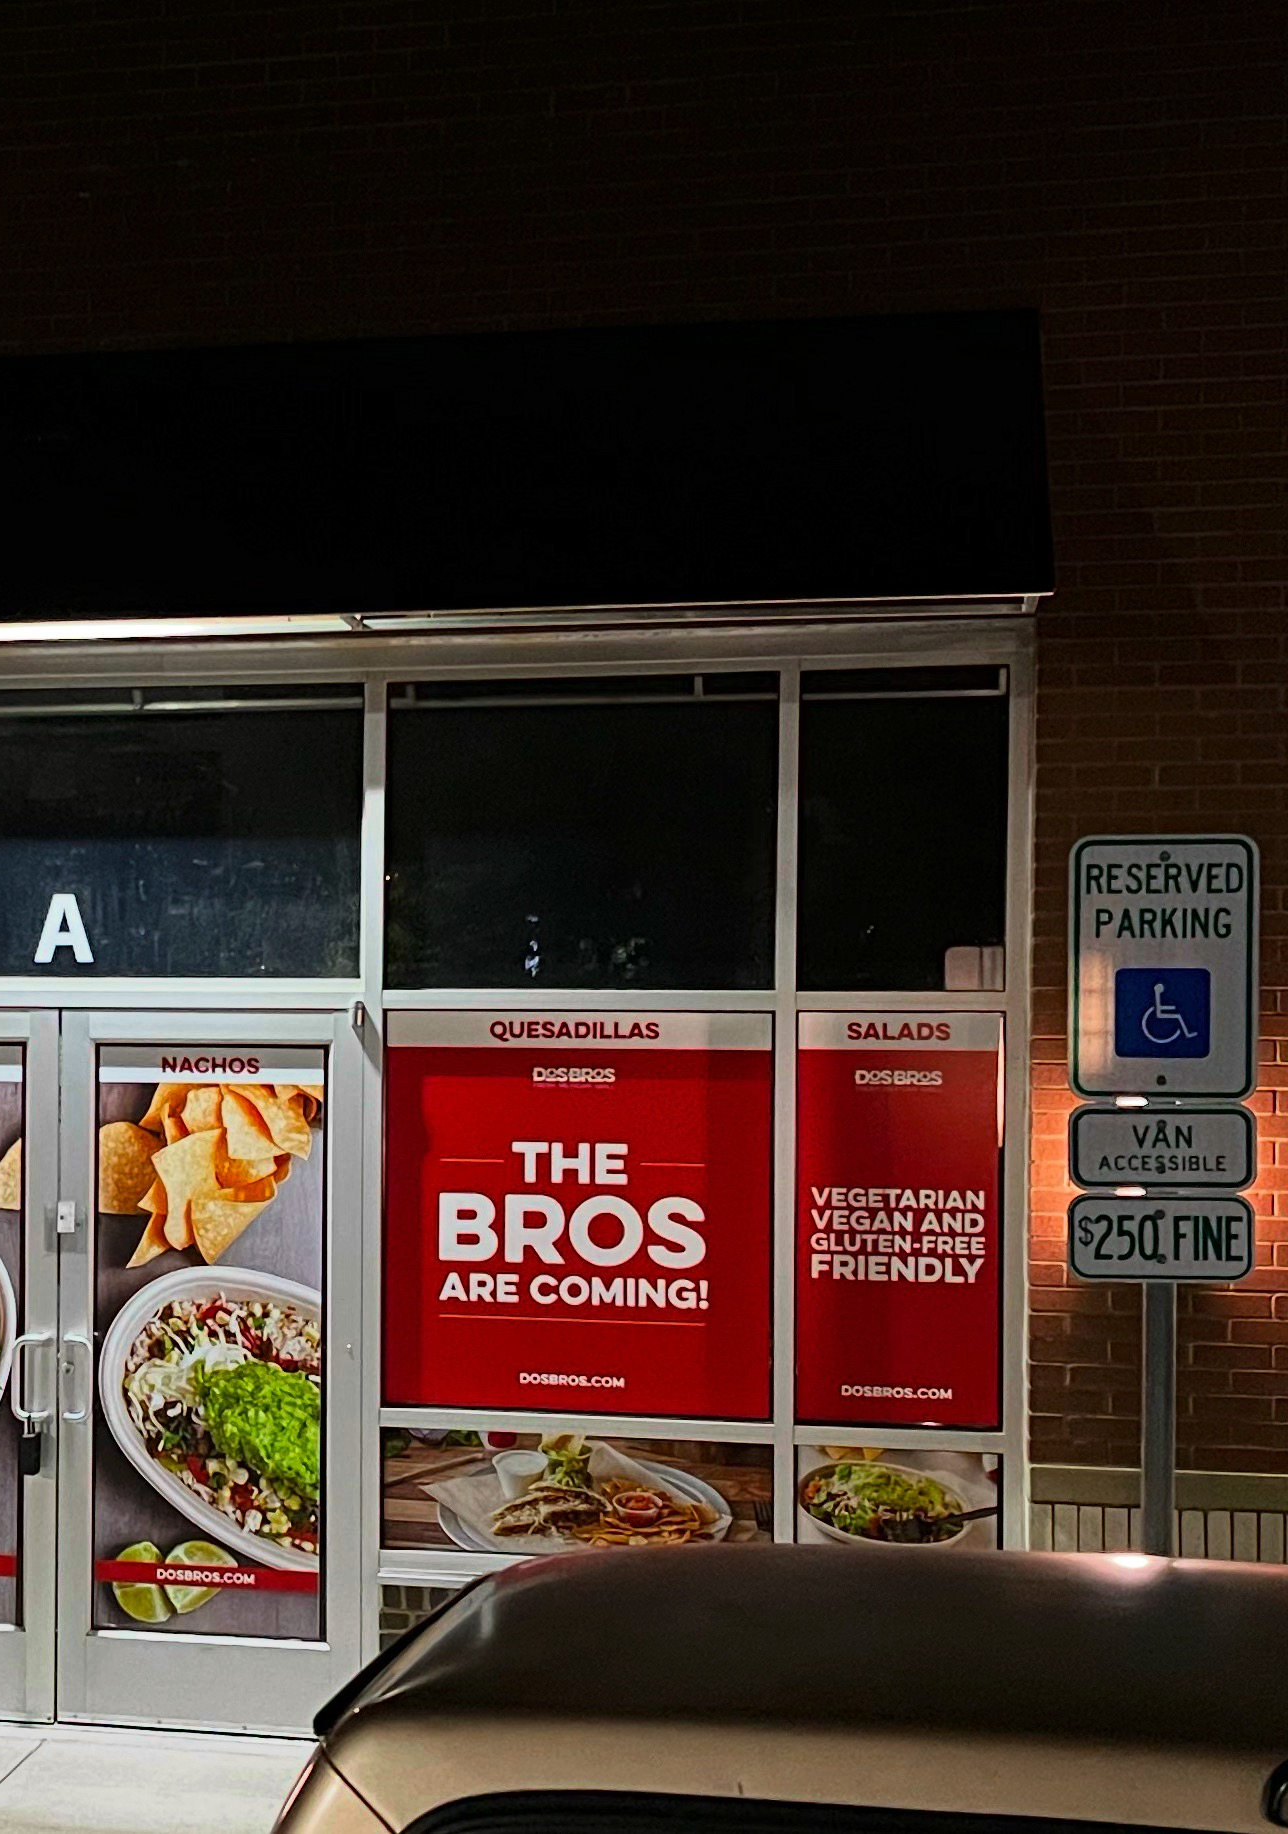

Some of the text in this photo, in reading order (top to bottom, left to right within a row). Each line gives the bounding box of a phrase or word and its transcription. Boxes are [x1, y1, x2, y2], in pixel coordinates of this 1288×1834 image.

[1085, 862, 1244, 895] RESERVED
[34, 893, 95, 964] A
[1095, 907, 1232, 939] PARKING
[489, 1020, 660, 1043] QUESADILLAS
[847, 1022, 951, 1041] SALADS
[159, 1054, 261, 1075] NACHOS
[1132, 1124, 1193, 1149] VAN
[511, 1141, 629, 1186] THE
[1098, 1155, 1227, 1172] ACCESSIBLE
[810, 1187, 985, 1210] VEGETARIAN
[438, 1192, 706, 1270] BROS
[810, 1210, 985, 1234] VEGAN AND
[810, 1233, 986, 1254] GLUTEN-FREE
[1078, 1214, 1244, 1262] $250 FINE
[811, 1255, 985, 1284] FRIENDLY
[439, 1272, 709, 1310] ARE COMING!
[519, 1372, 625, 1388] DOSBROS.COM
[841, 1384, 953, 1400] DOSBROS.COM
[155, 1567, 256, 1586] DOSBROS.COM
